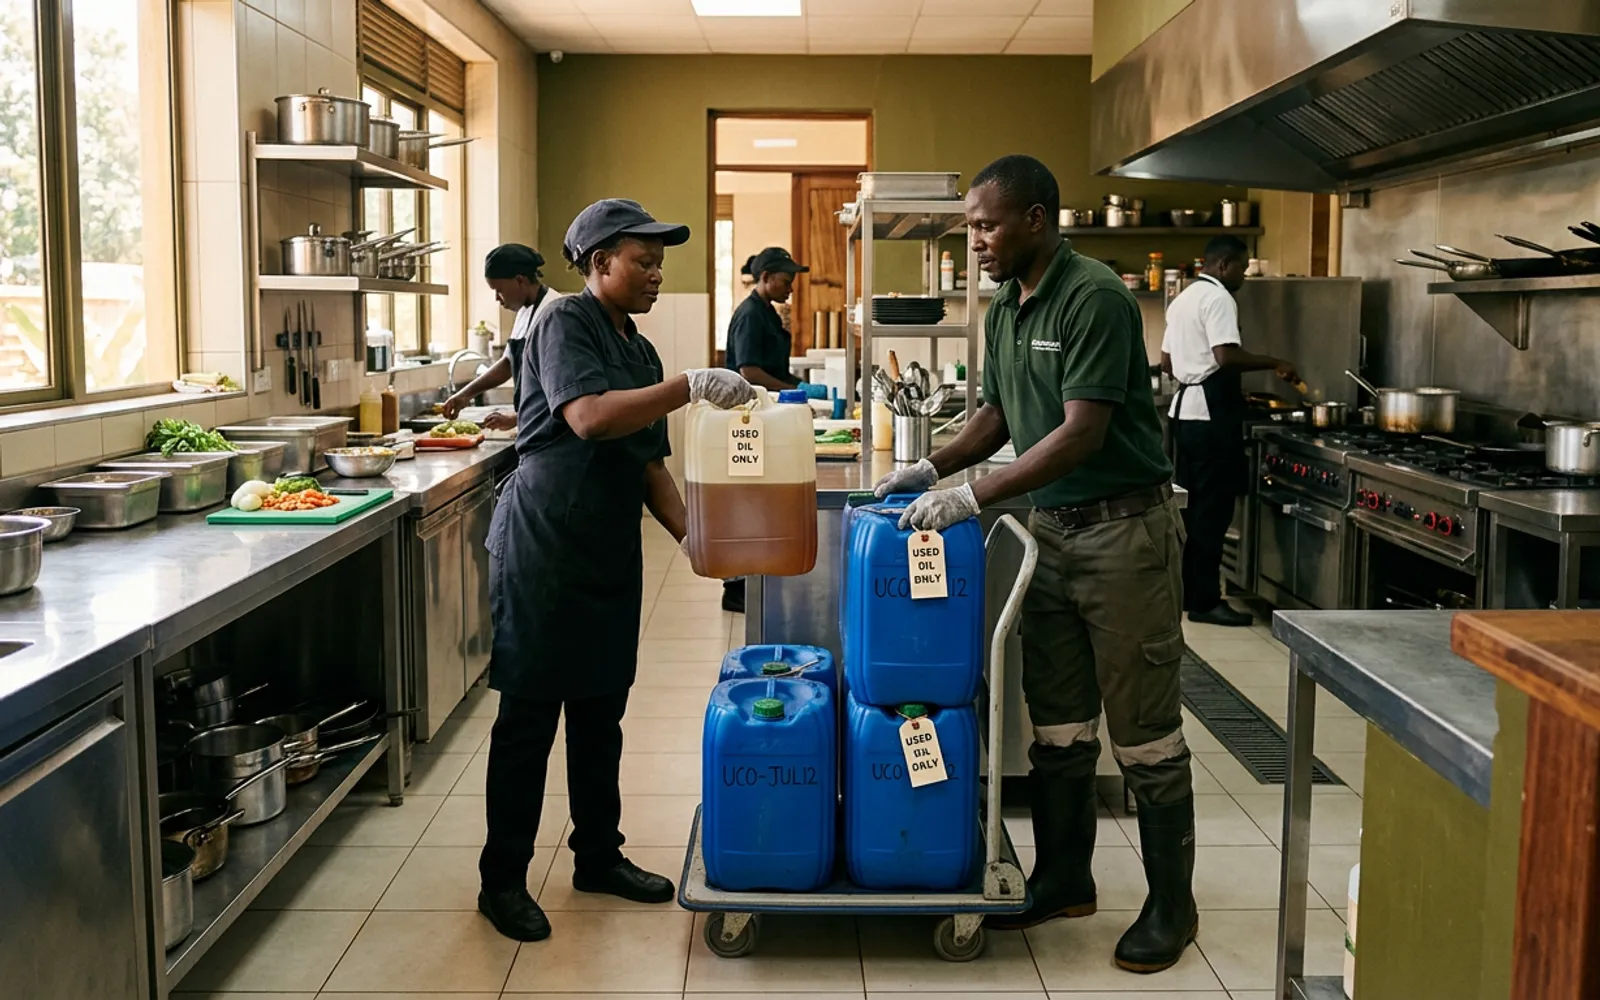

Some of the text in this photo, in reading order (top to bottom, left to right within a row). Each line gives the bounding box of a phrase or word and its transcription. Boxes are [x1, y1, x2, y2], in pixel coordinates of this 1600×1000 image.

[731, 455, 759, 464] ONLY
[912, 548, 940, 557] USED
[918, 561, 935, 570] OIL
[905, 733, 932, 746] USED
[722, 765, 818, 787] UCO-JUL12
